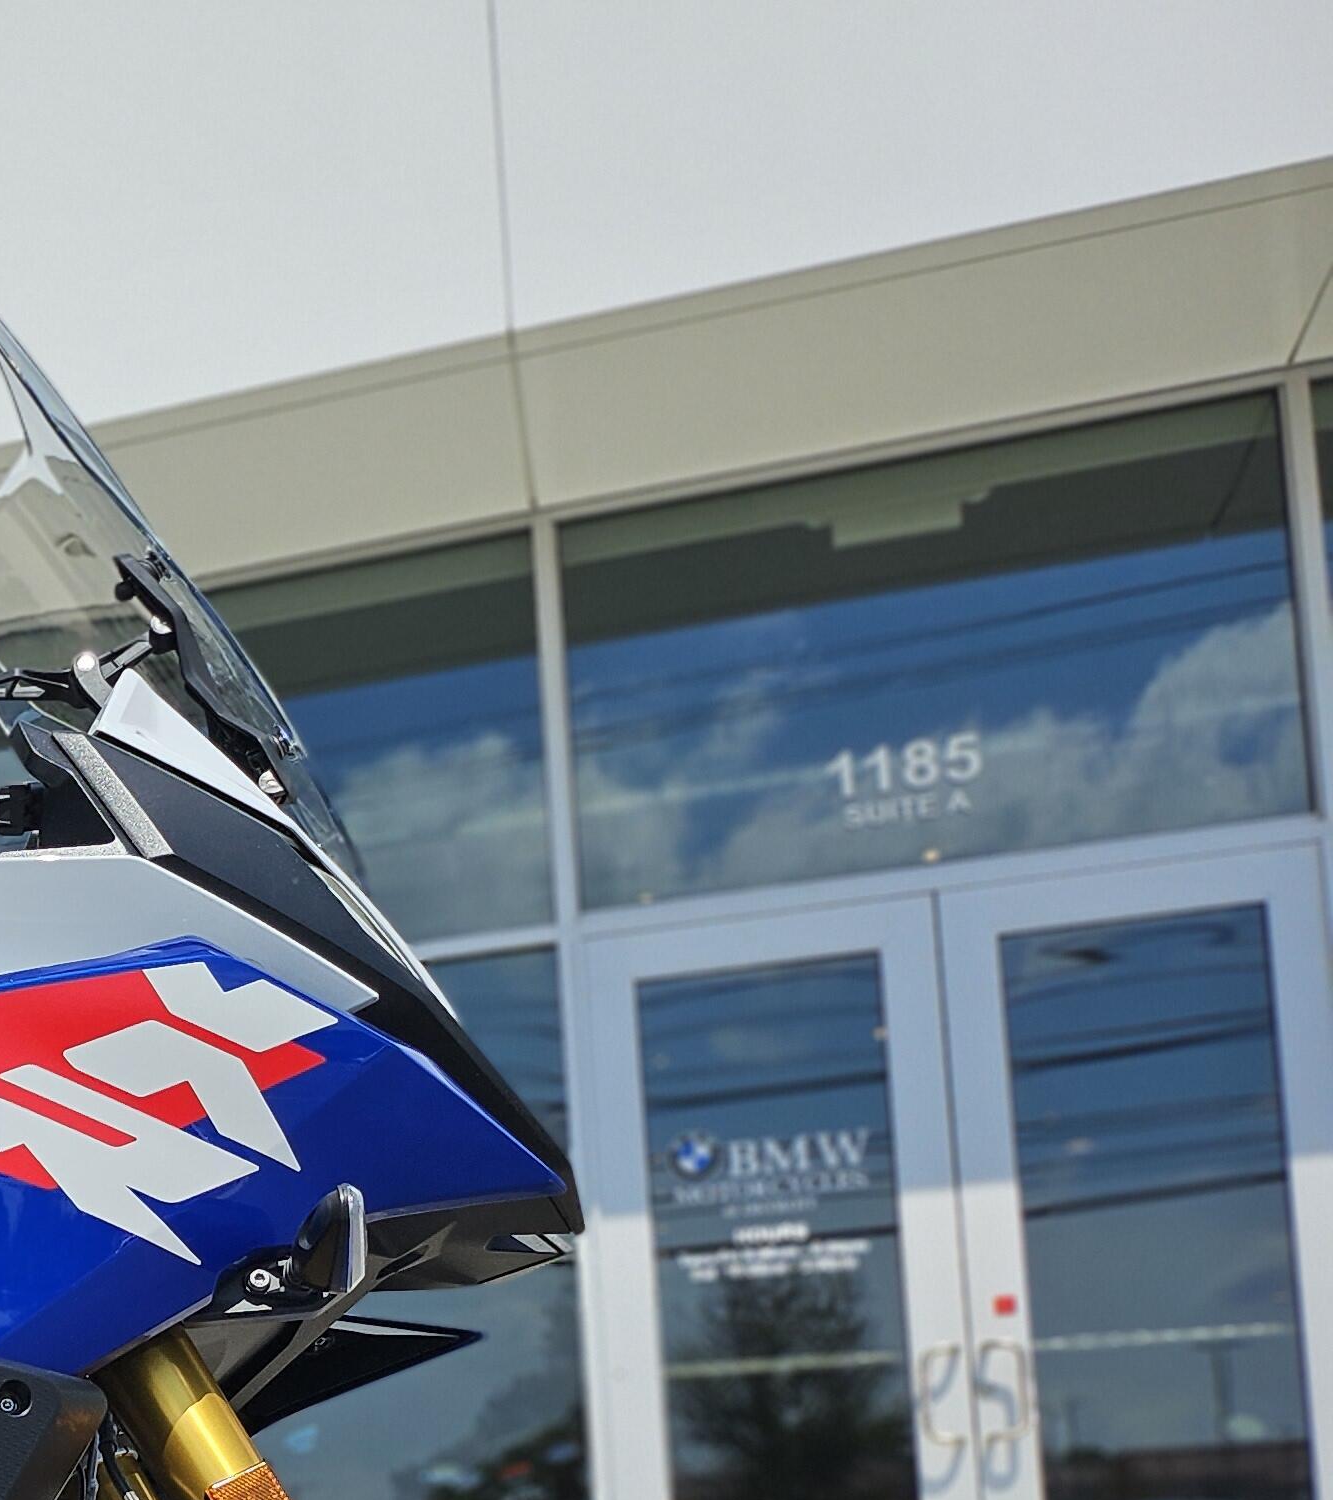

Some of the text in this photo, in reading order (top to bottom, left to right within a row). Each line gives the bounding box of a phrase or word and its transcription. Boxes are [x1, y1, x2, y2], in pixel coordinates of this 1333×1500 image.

[827, 731, 983, 797] 1185
[843, 790, 972, 830] SUITE A
[730, 1131, 869, 1175] BMW
